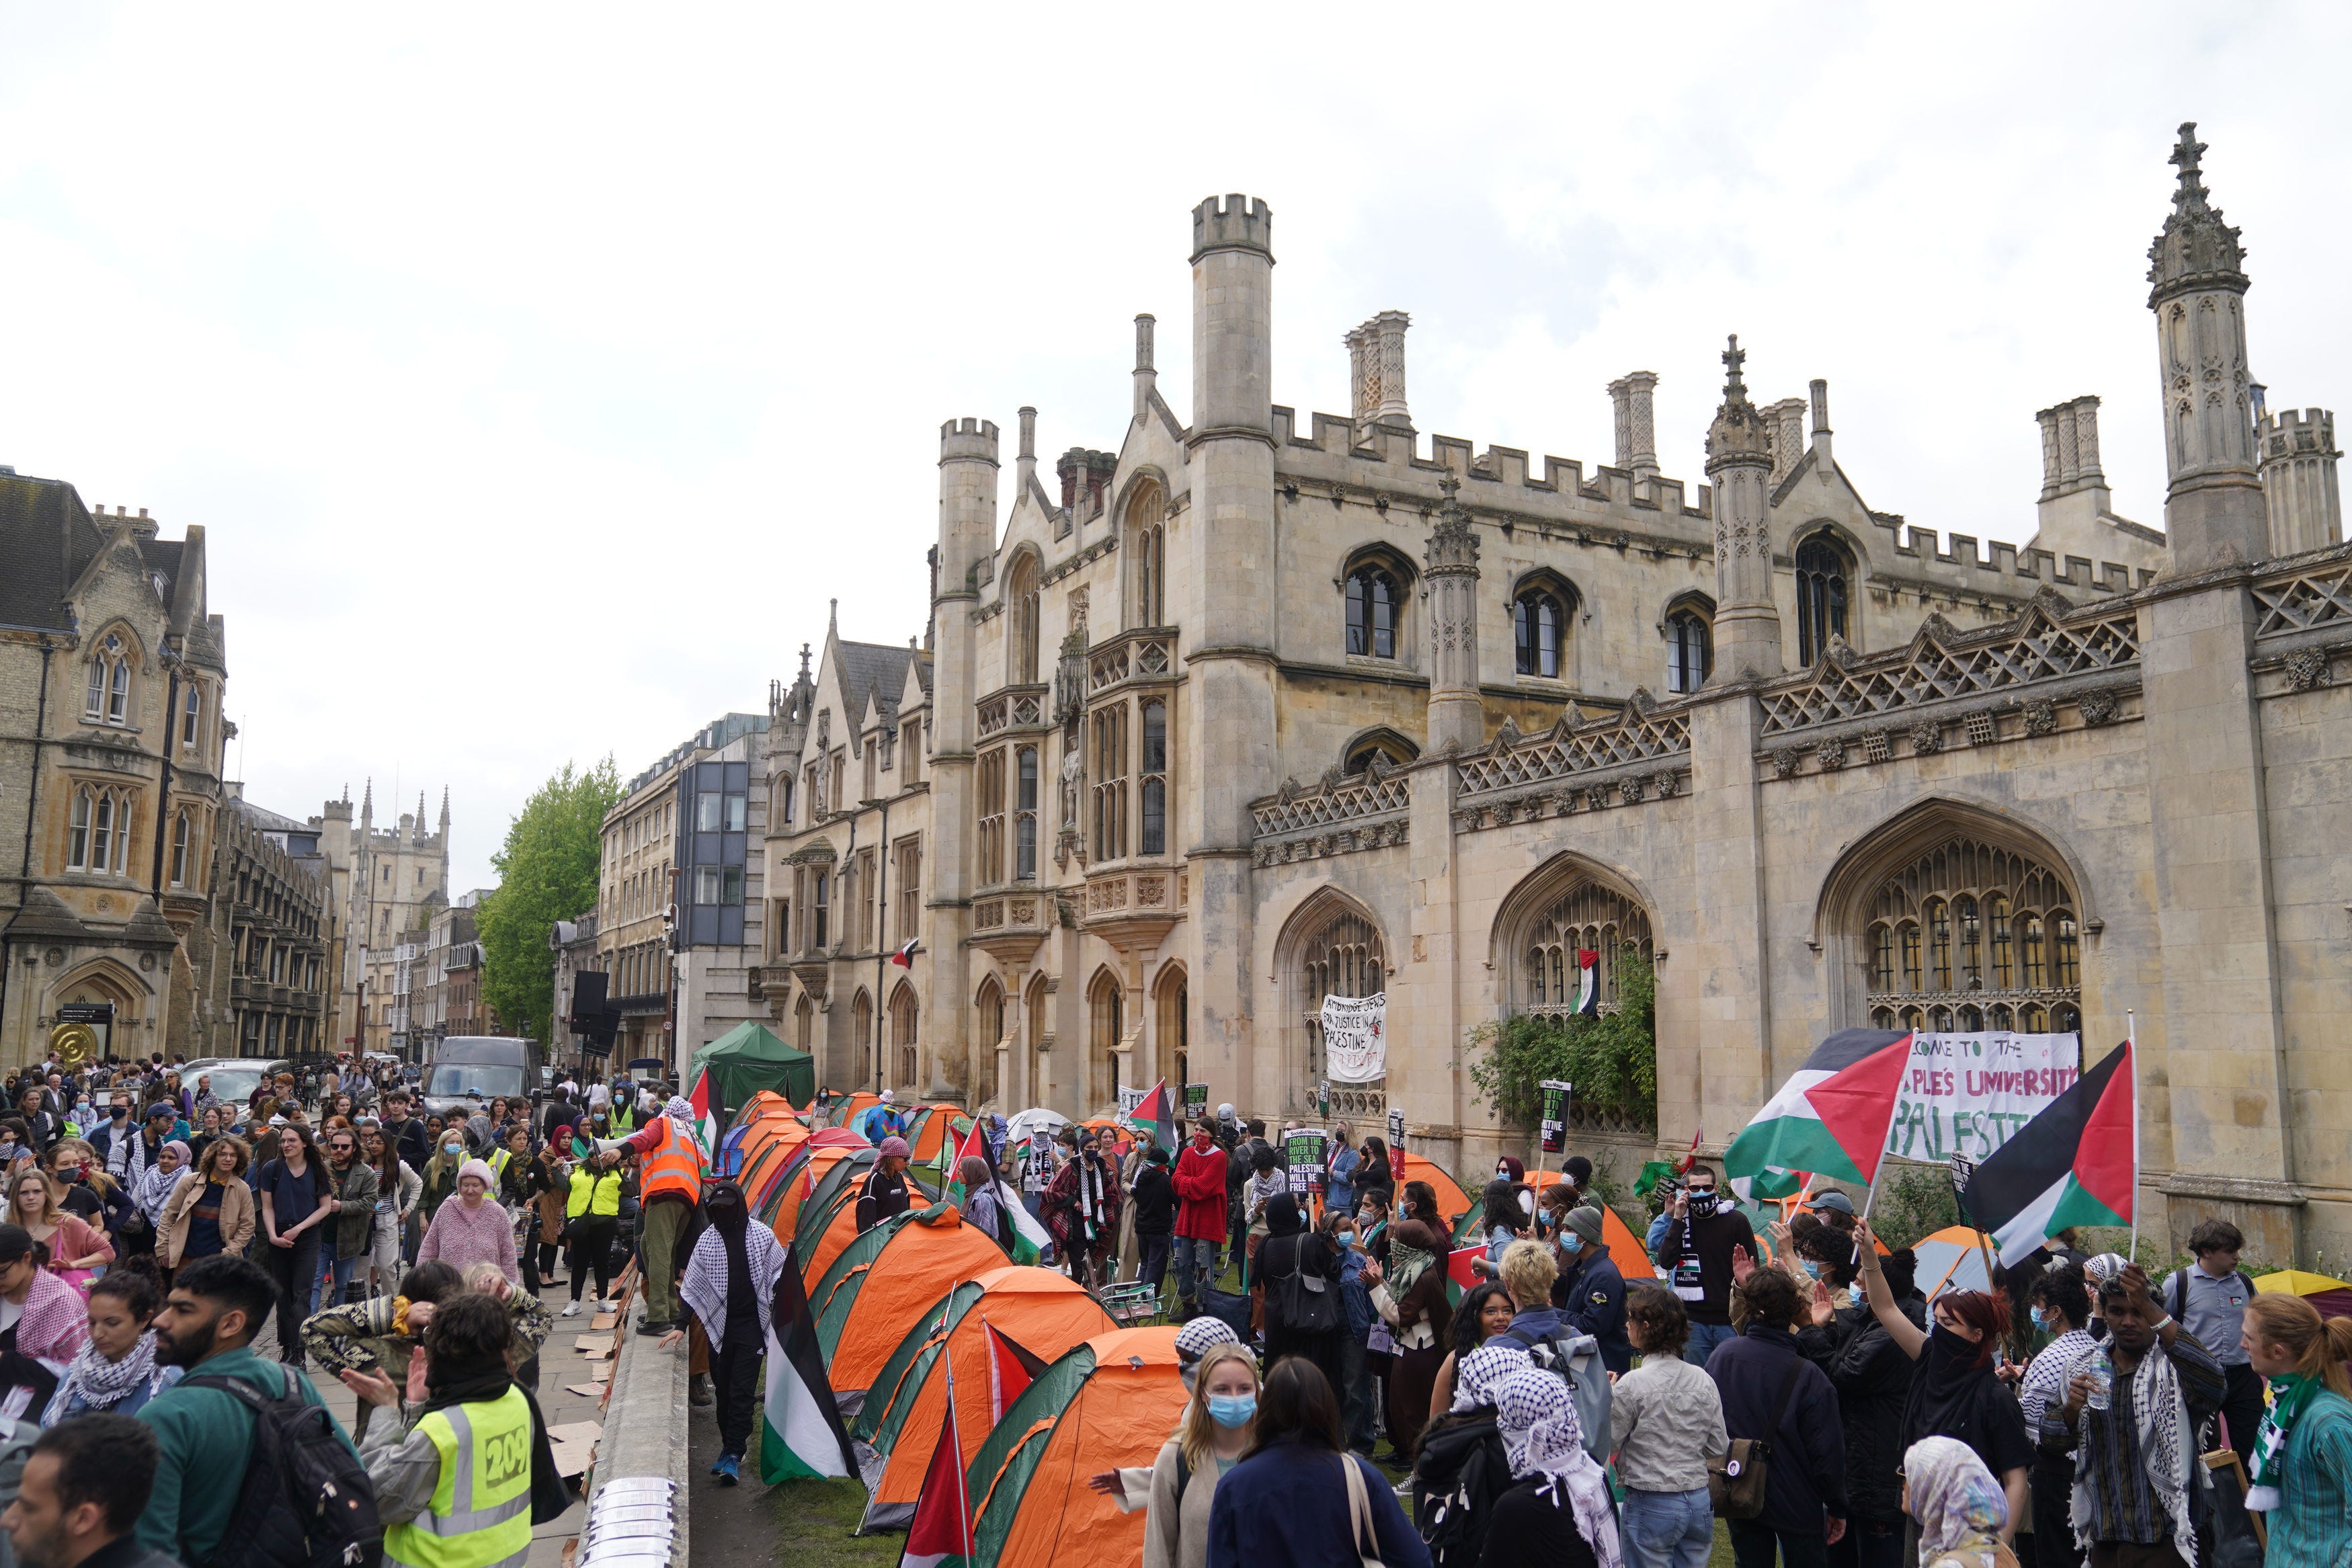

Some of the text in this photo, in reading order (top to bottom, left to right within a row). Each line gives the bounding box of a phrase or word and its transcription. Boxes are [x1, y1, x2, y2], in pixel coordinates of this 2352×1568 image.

[1326, 994, 1385, 1013] AMBRIDGE JEWS
[1324, 1012, 1369, 1028] FOR JUSTICE IN
[1325, 1027, 1365, 1050] PALESTINE
[1912, 1040, 2022, 1058] COME TO THE
[1912, 1065, 2078, 1097] PLE'S UNIVERSITY
[1289, 1137, 1322, 1147] FROM THE
[1289, 1146, 1319, 1155] RIVER TO
[1289, 1155, 1316, 1164] THE SEA
[1289, 1164, 1324, 1173] PALESTINE
[1289, 1173, 1317, 1182] WILL BE
[1289, 1182, 1307, 1192] FREE
